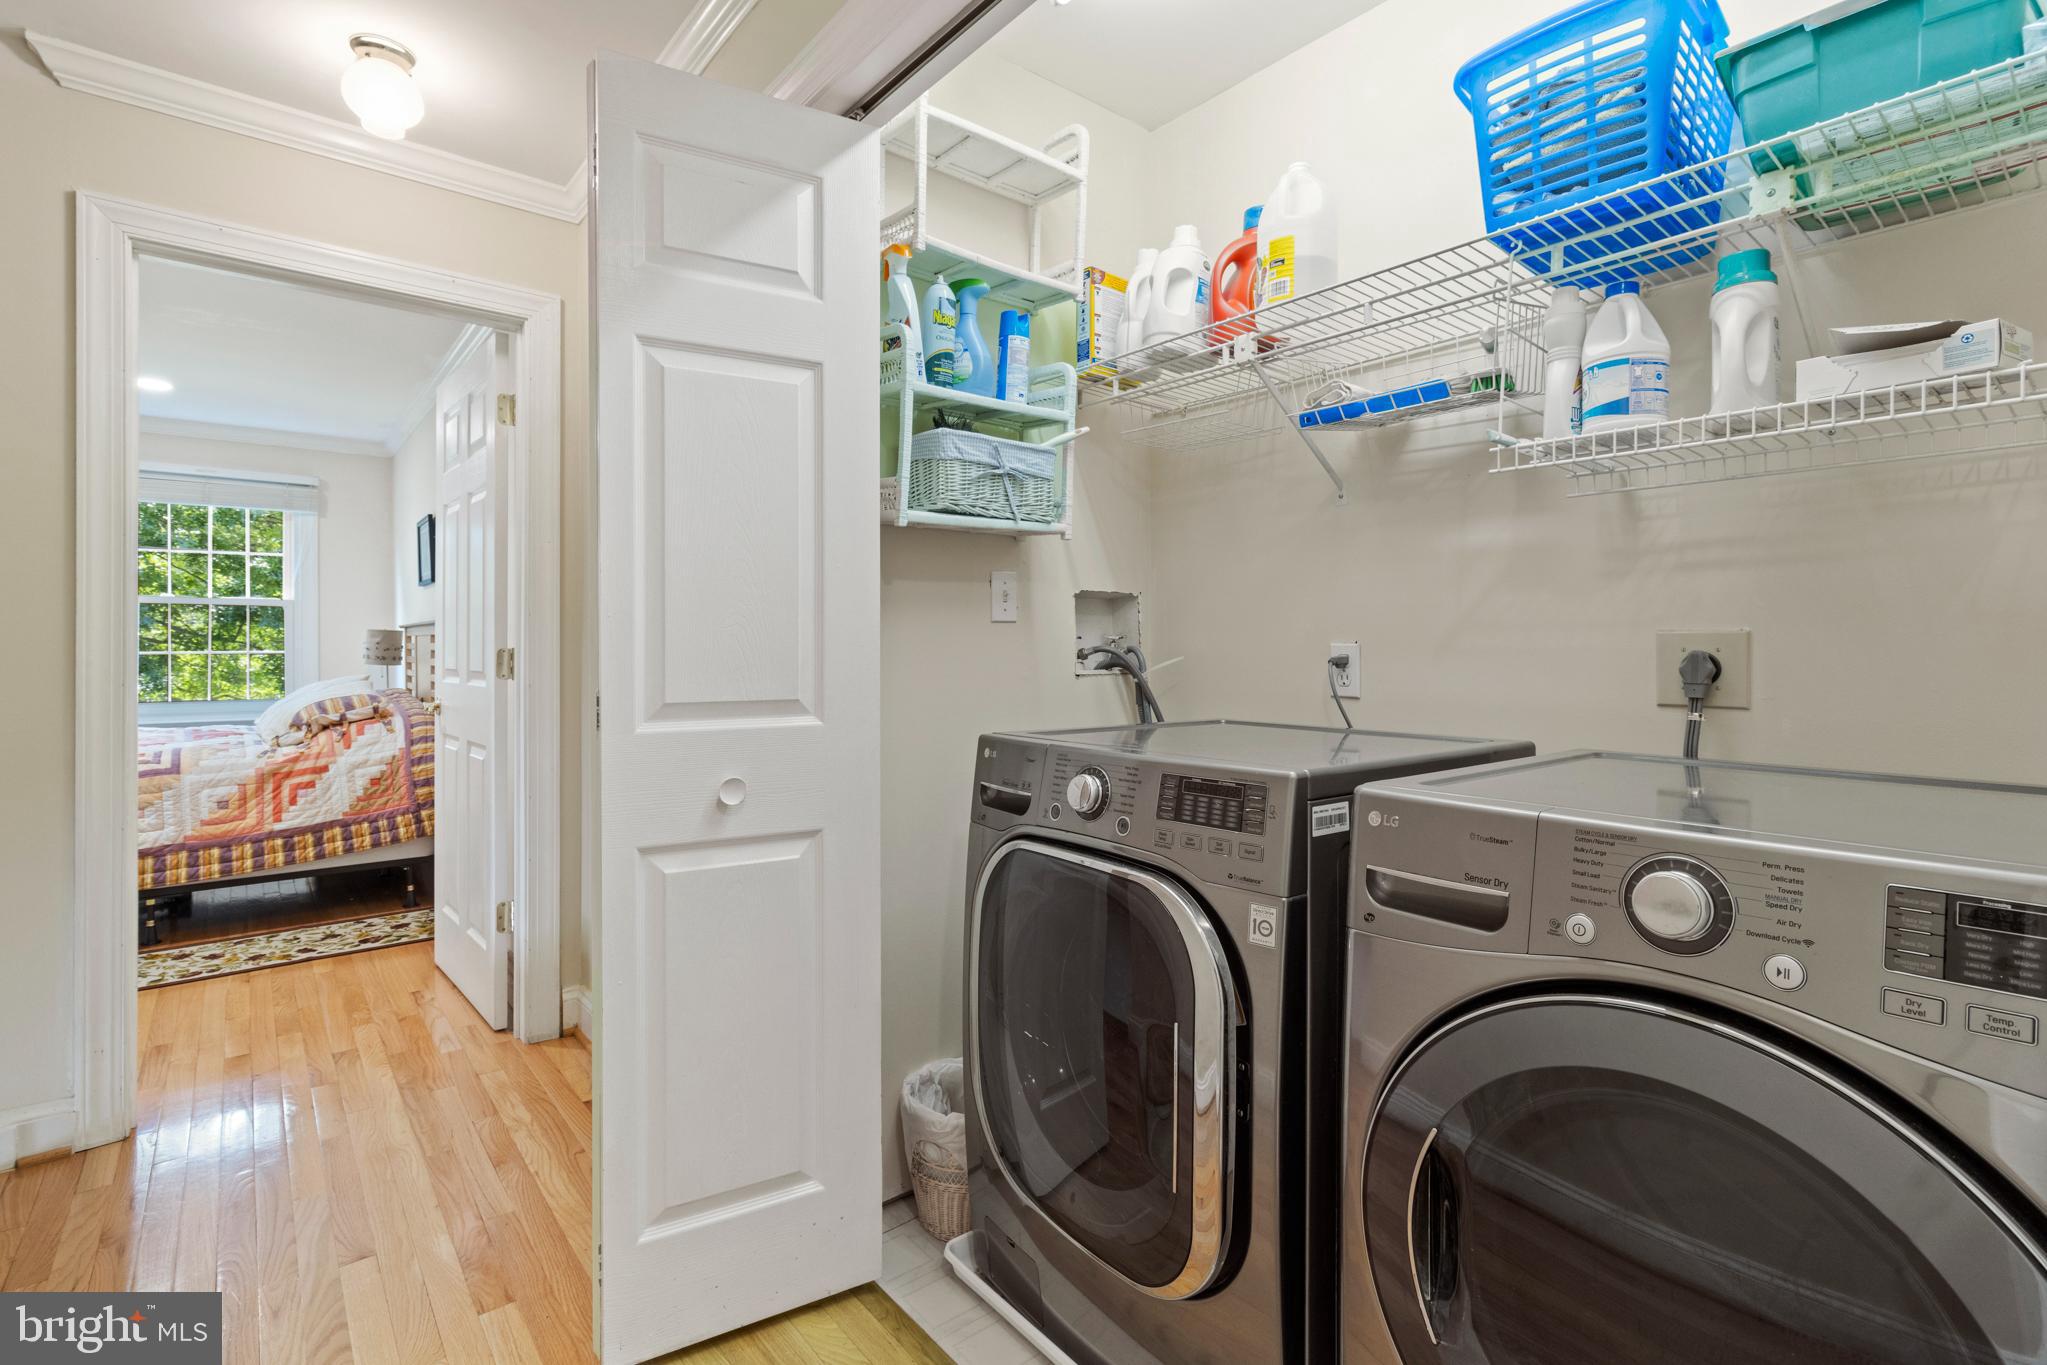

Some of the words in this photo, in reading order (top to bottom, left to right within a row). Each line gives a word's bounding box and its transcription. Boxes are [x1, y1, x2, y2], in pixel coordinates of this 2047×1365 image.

[1383, 814, 1400, 828] LG
[1574, 836, 1616, 847] Cotton/Normal
[1573, 846, 1607, 857] Bulky/Large
[1573, 857, 1590, 866] Heavy
[1591, 860, 1604, 868] Duty
[1762, 861, 1783, 871] Perm.
[1784, 864, 1805, 874] Press
[1572, 869, 1587, 878] Small
[1587, 871, 1600, 879] Load
[1770, 874, 1805, 886] Delicates
[1464, 872, 1492, 887] Sensor
[1493, 877, 1510, 891] Dry
[1571, 882, 1589, 890] Steam
[1777, 886, 1804, 897] Towels
[1570, 895, 1587, 905] Steam
[1764, 893, 1789, 903] MANUAL
[1765, 900, 1788, 911] Speed
[1789, 904, 1803, 914] Dry
[1252, 917, 1274, 938] 10
[1788, 920, 1802, 930] Dry
[1746, 929, 1781, 942] Download
[1781, 935, 1802, 946] Cycle
[1905, 997, 1923, 1009] Dry
[1900, 1006, 1926, 1018] Level
[1986, 1014, 2017, 1028] Temp.
[1982, 1022, 2021, 1038] Control
